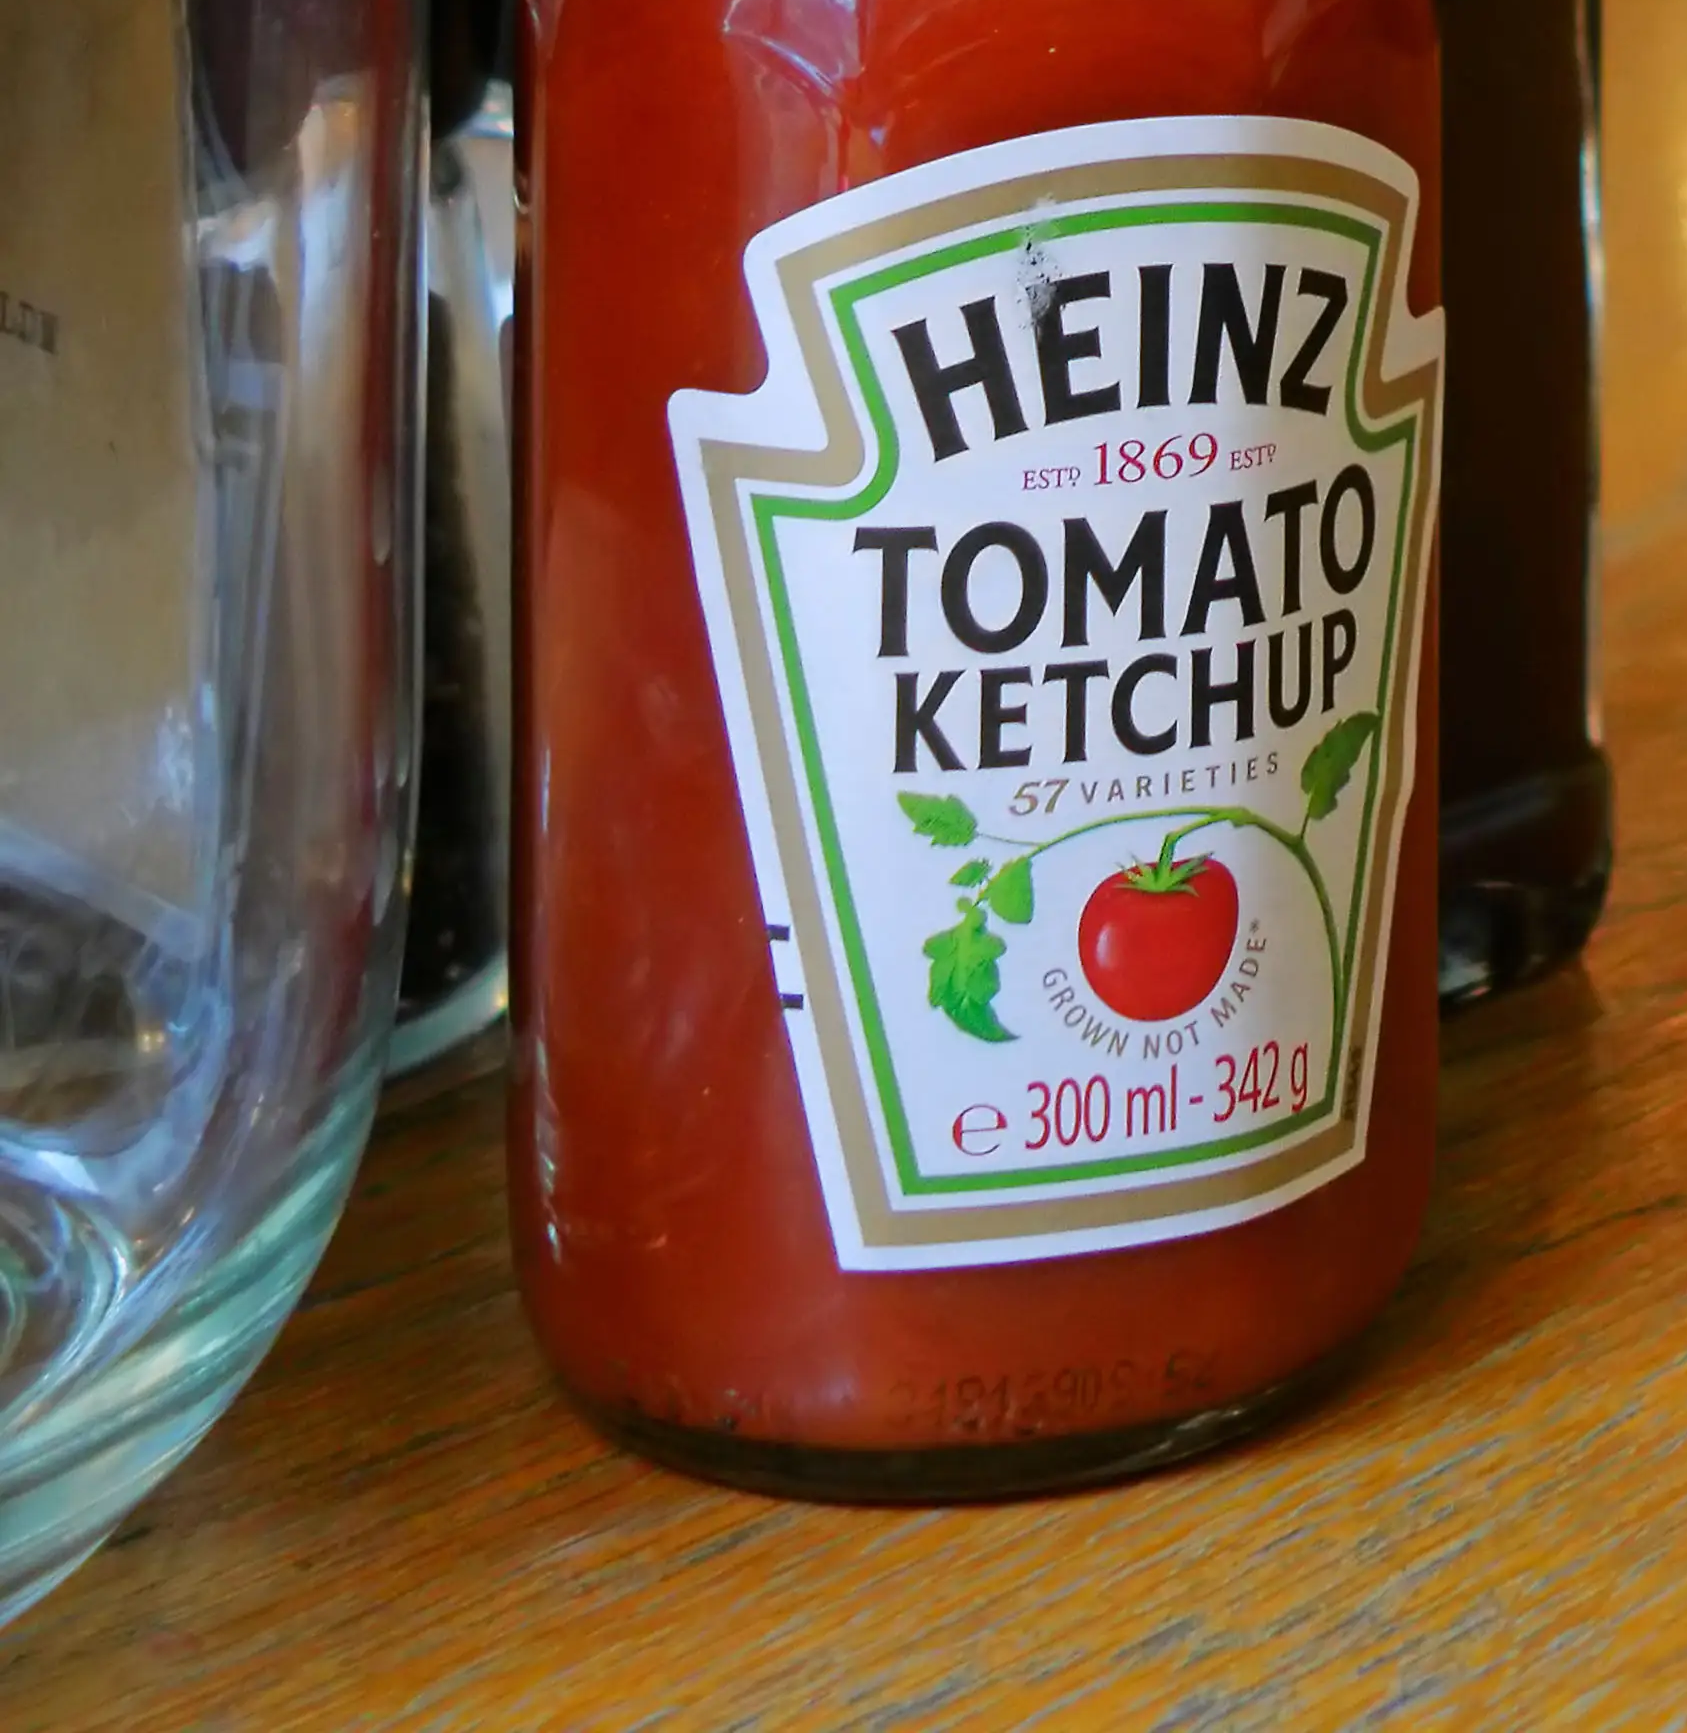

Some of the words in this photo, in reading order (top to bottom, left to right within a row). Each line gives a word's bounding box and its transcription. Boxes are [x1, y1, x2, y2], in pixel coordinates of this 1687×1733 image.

[891, 261, 1349, 464] HEINZ
[1093, 432, 1219, 486] 1869
[852, 464, 1376, 659] TOMATO
[892, 608, 1357, 775] KETCHUP
[1009, 778, 1070, 816] 57
[1080, 752, 1279, 805] VARIETIES
[1042, 967, 1130, 1058] GROWN
[1143, 1020, 1200, 1060] NOT
[1025, 1074, 1111, 1150] 300
[1125, 1063, 1178, 1138] ml
[1212, 1040, 1280, 1123] 342
[1289, 1042, 1308, 1114] g
